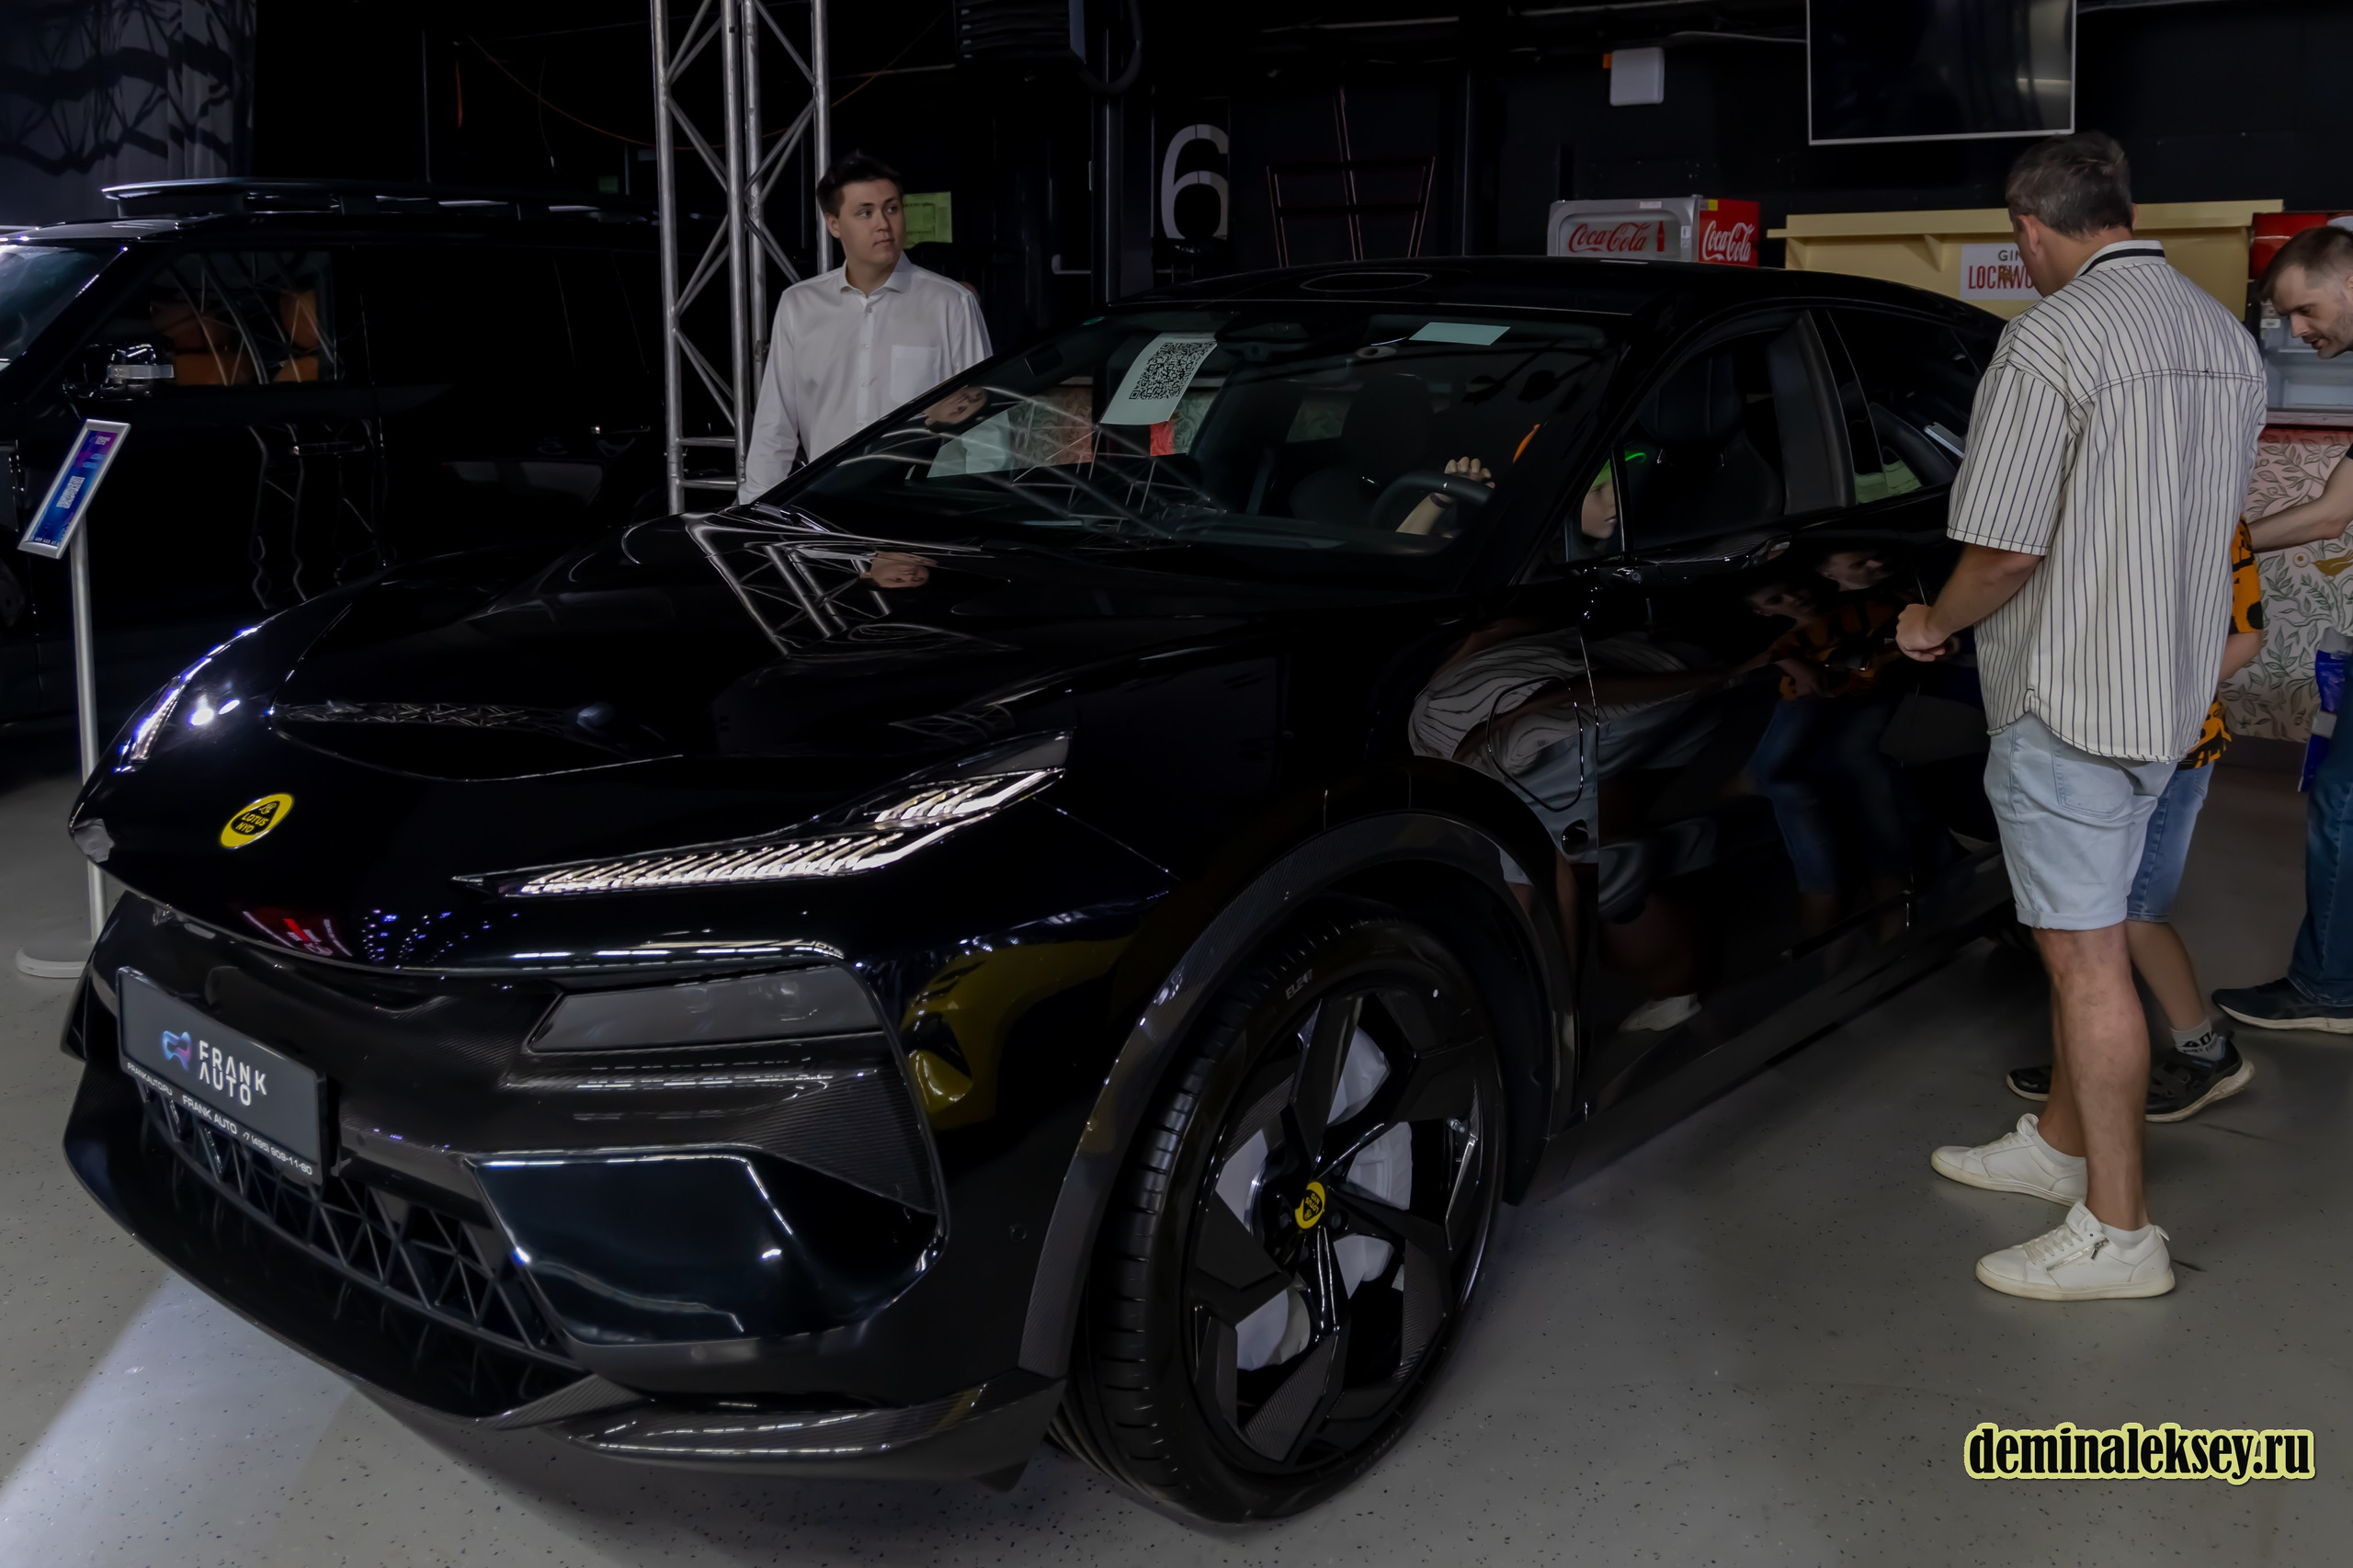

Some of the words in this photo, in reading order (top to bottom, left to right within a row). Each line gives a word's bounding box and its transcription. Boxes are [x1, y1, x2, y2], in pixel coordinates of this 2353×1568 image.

[1160, 123, 1230, 241] 6
[241, 812, 269, 826] LOTUS
[199, 1040, 267, 1096] FRANK
[199, 1062, 252, 1107] AUTO
[182, 1095, 211, 1120] FRANK
[213, 1113, 238, 1135] AUTO
[1305, 1197, 1320, 1213] LOTUS
